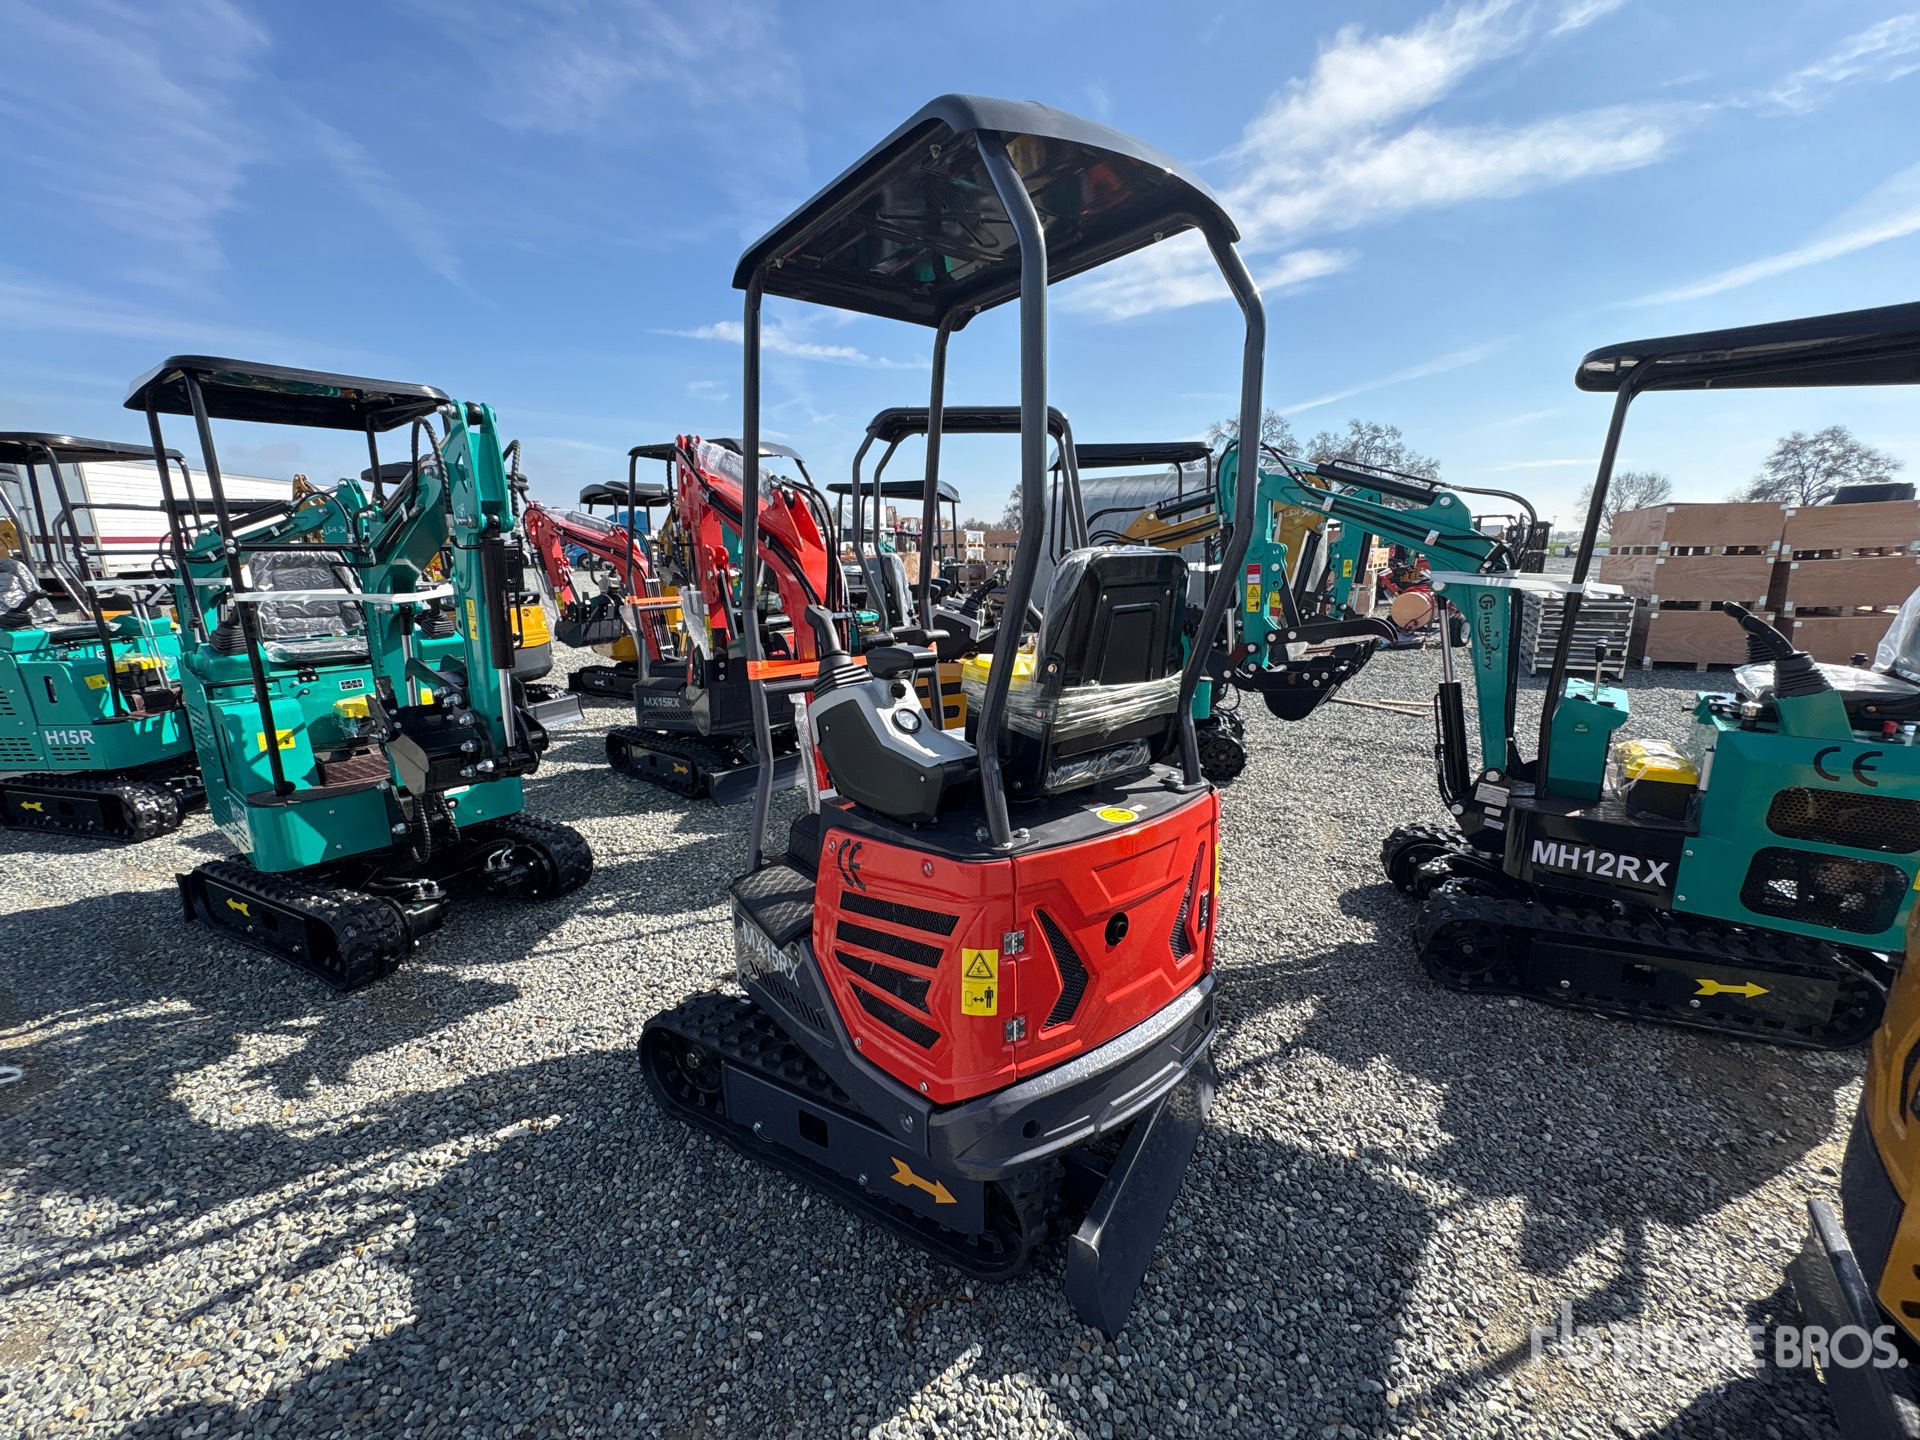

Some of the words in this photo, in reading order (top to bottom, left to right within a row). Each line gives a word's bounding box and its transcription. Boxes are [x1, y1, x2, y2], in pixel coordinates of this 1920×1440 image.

[643, 697, 681, 708] MX15RX
[44, 729, 96, 746] H15R
[1531, 839, 1671, 887] MH12RX
[742, 920, 800, 988] MX15RX
